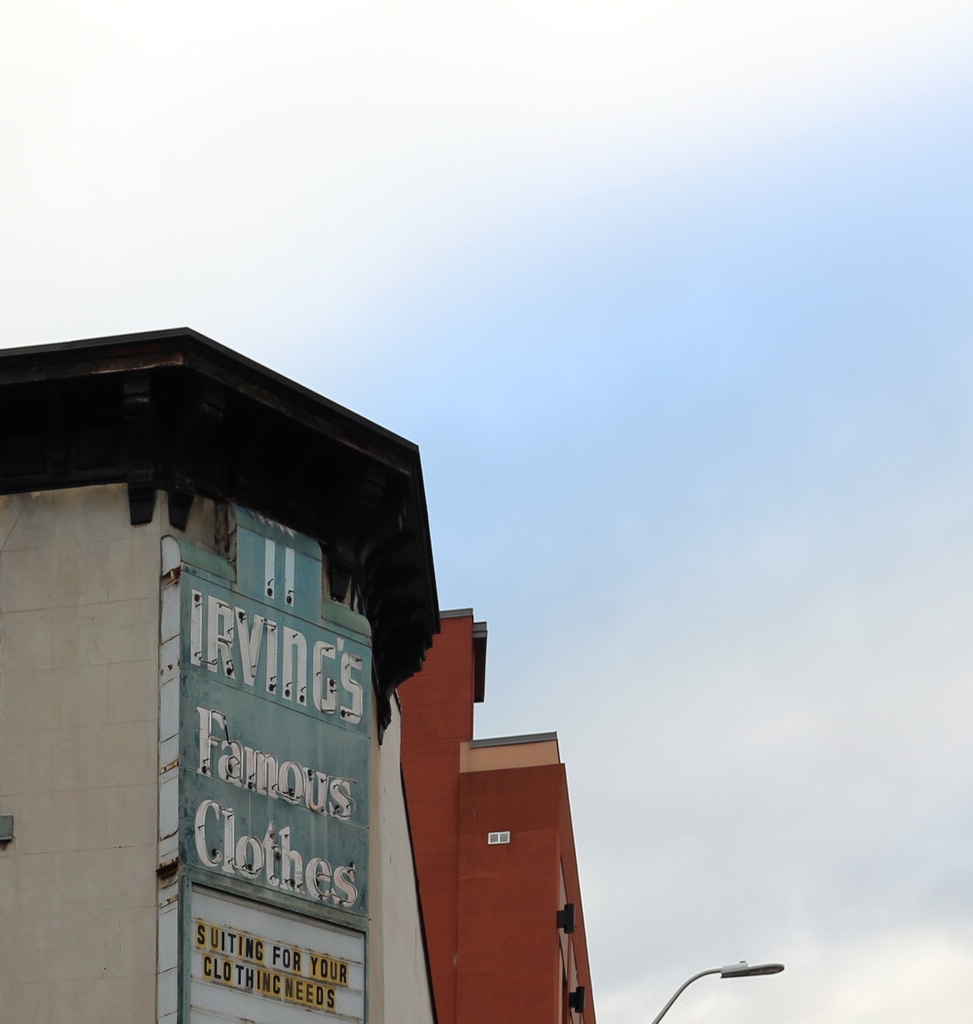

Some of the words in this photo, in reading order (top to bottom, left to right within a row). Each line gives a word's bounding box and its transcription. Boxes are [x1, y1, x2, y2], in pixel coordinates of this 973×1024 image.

[190, 589, 364, 725] IRVING'S
[195, 706, 358, 821] Famous
[194, 800, 359, 908] Clothes
[197, 924, 264, 961] SUITING
[273, 945, 301, 972] FOR
[310, 955, 347, 984] YOUR
[285, 977, 335, 1009] NEEDS
